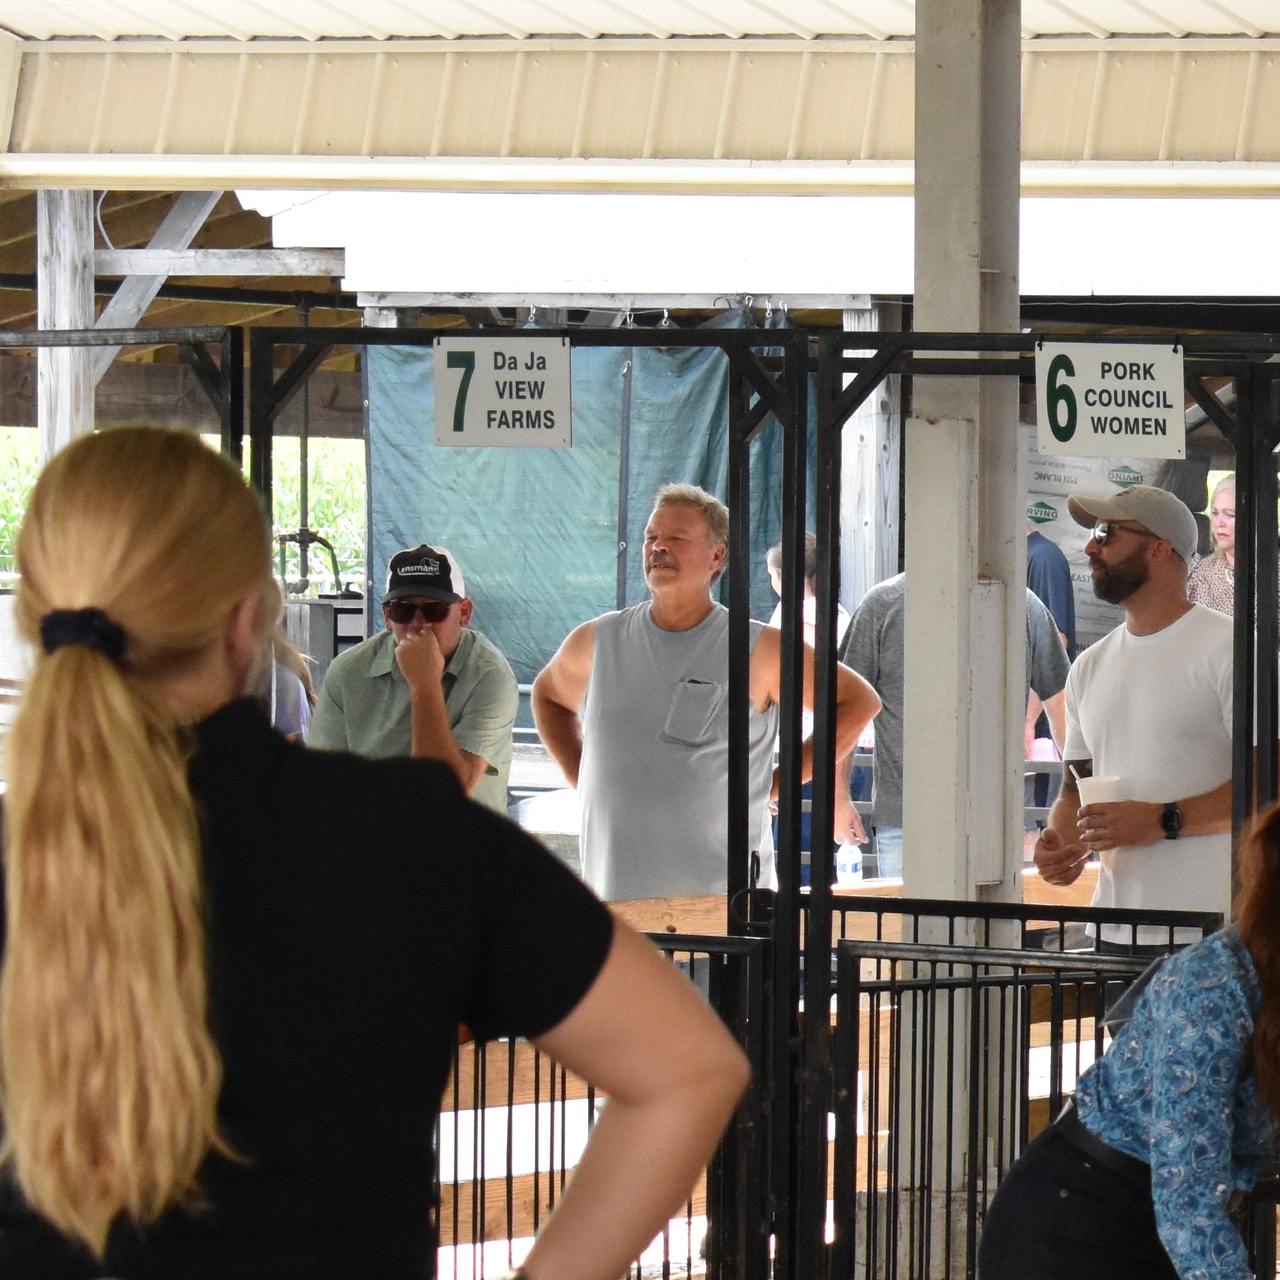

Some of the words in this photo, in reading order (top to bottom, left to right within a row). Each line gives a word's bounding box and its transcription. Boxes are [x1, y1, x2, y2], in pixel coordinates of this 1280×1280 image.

[493, 351, 518, 371] Da
[524, 351, 547, 371] Ja
[1100, 361, 1156, 381] PORK
[446, 350, 476, 433] 7
[494, 380, 546, 400] VIEW
[1046, 353, 1078, 443] 6
[1084, 388, 1174, 409] COUNCIL
[486, 409, 555, 430] FARMS
[1090, 416, 1167, 436] WOMEN
[1108, 471, 1144, 482] IRVING
[1027, 507, 1058, 519] RVING
